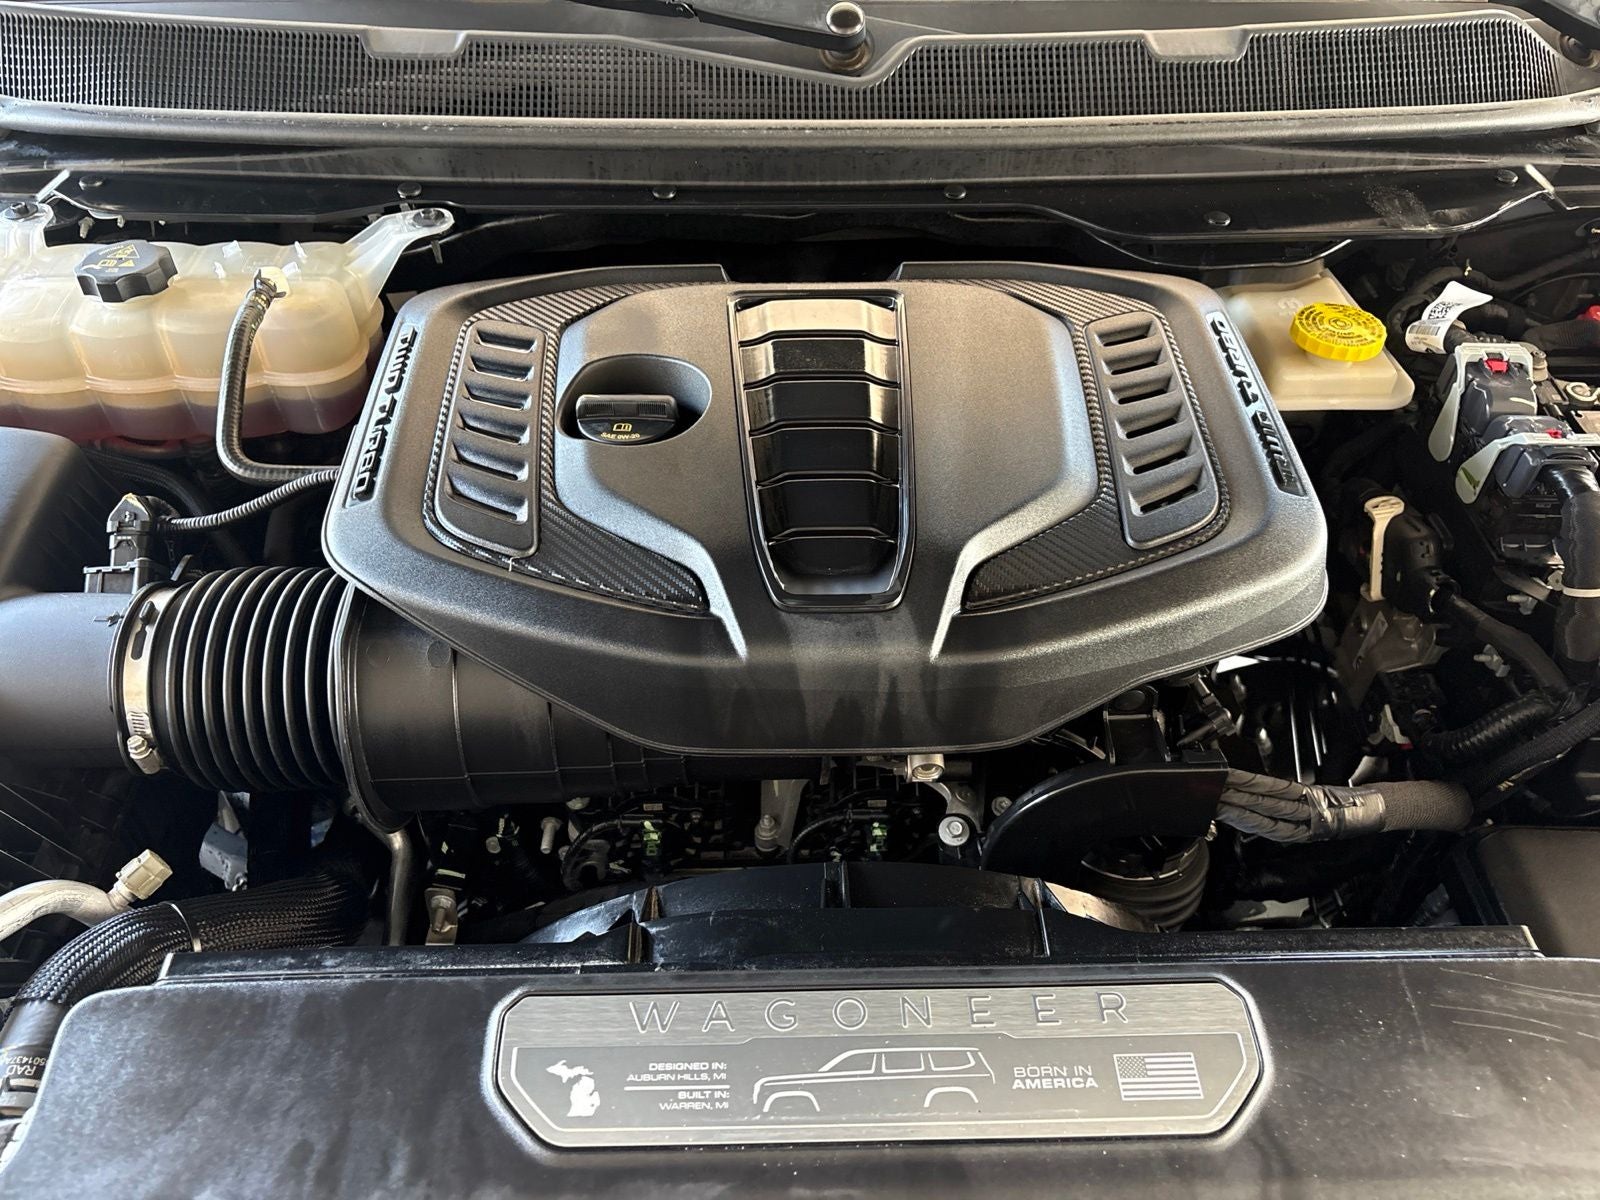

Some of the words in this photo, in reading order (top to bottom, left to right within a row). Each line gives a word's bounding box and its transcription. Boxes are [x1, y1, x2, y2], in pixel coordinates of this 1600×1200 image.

[1210, 317, 1259, 407] TURBO
[354, 393, 397, 501] TURBO
[629, 991, 1129, 1034] WAGONEER
[6, 1064, 37, 1076] RAD
[648, 1062, 710, 1071] DESIGNED
[711, 1062, 728, 1071] IN:
[1013, 1066, 1068, 1078] BORN
[1073, 1065, 1093, 1077] IN
[626, 1073, 676, 1082] AUBURN
[677, 1073, 711, 1082] HILLS,
[713, 1072, 727, 1080] MI
[1012, 1077, 1099, 1090] AMERICA
[678, 1091, 712, 1100] BUILT
[714, 1090, 730, 1099] IN:
[659, 1102, 713, 1110] WARREN,
[715, 1101, 729, 1109] MI
